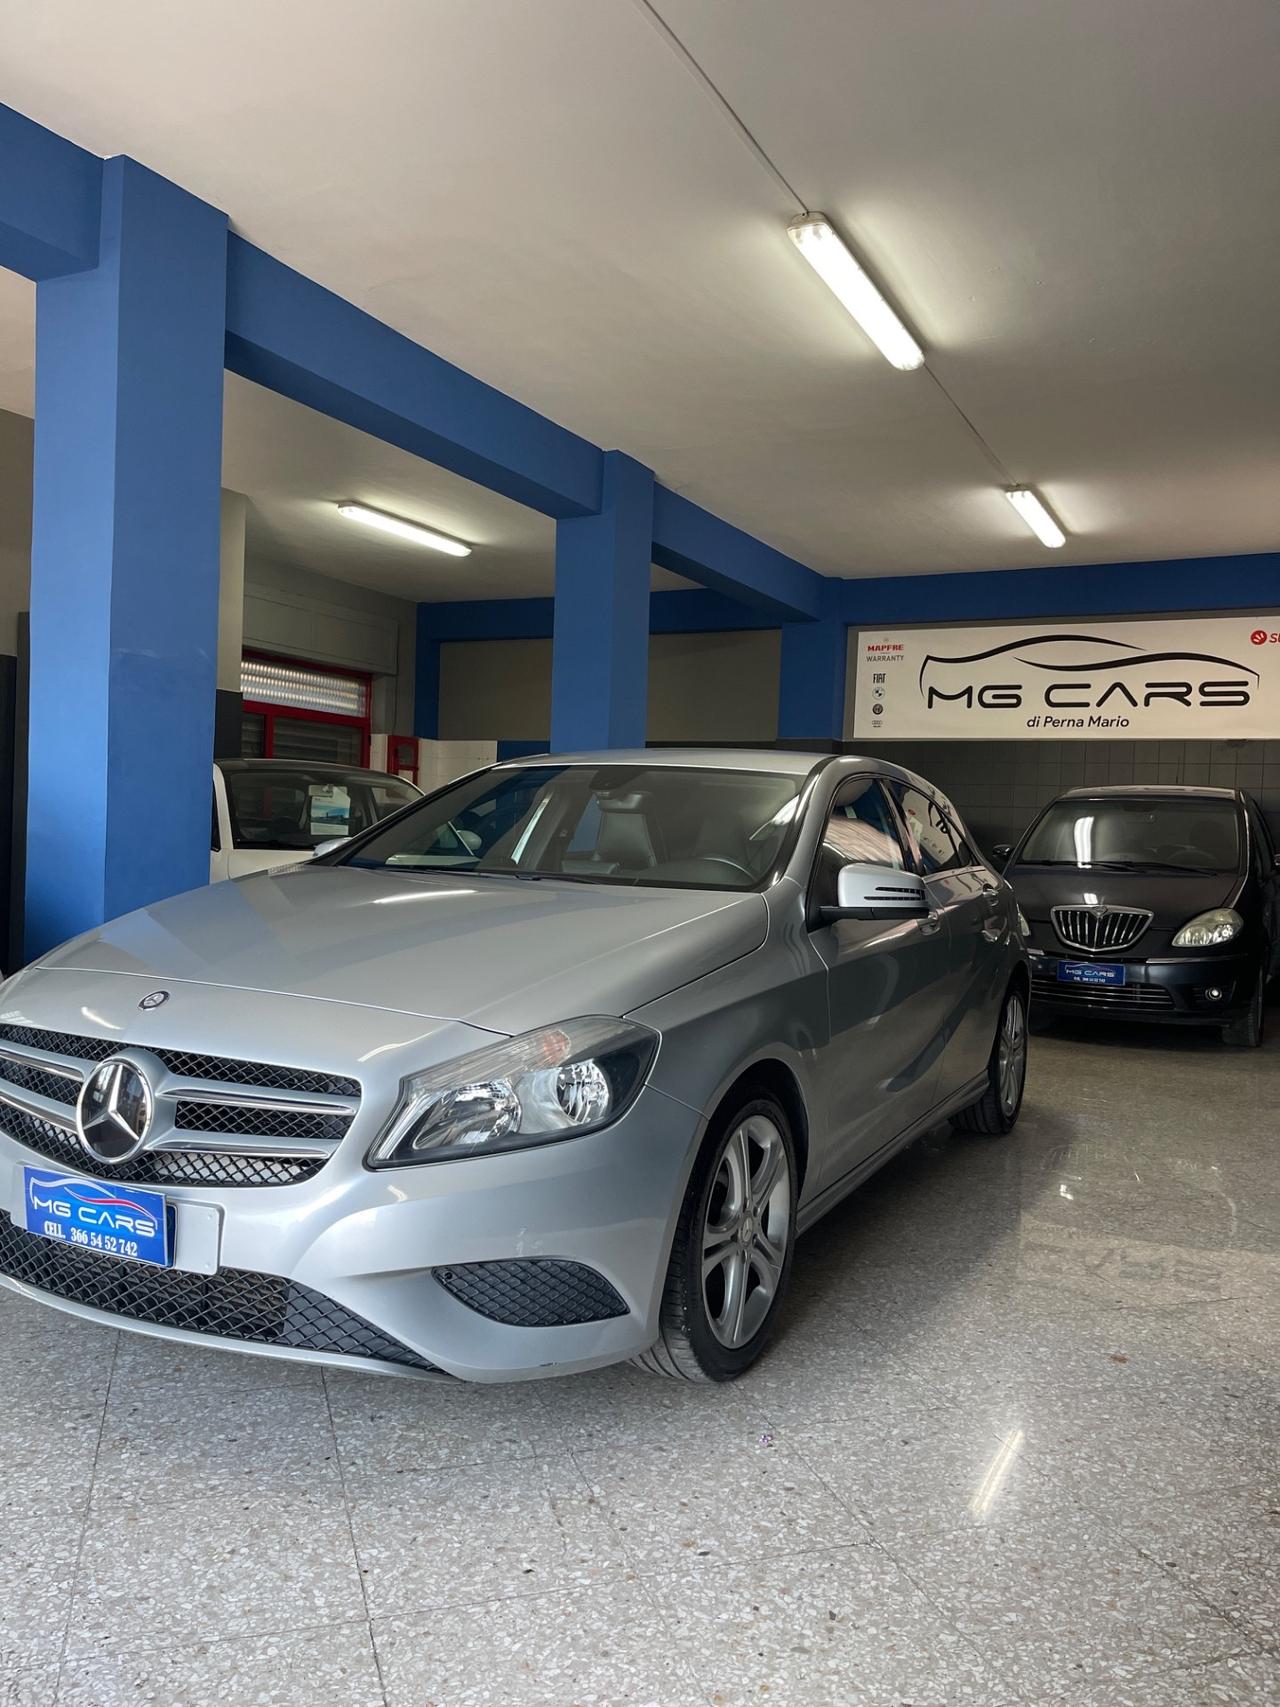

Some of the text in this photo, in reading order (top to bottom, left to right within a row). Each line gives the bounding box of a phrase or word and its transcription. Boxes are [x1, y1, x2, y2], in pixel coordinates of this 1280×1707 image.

[867, 644, 904, 652] MAPFRE
[873, 673, 886, 683] FIAT
[928, 681, 1250, 709] MG CARS
[1026, 715, 1130, 728] di Perna Mario
[1084, 970, 1115, 978] CARS
[33, 1196, 156, 1238] MG CARS
[70, 1226, 89, 1245] 366
[90, 1232, 103, 1249] 54
[104, 1235, 117, 1252] 52
[119, 1238, 138, 1257] 742
